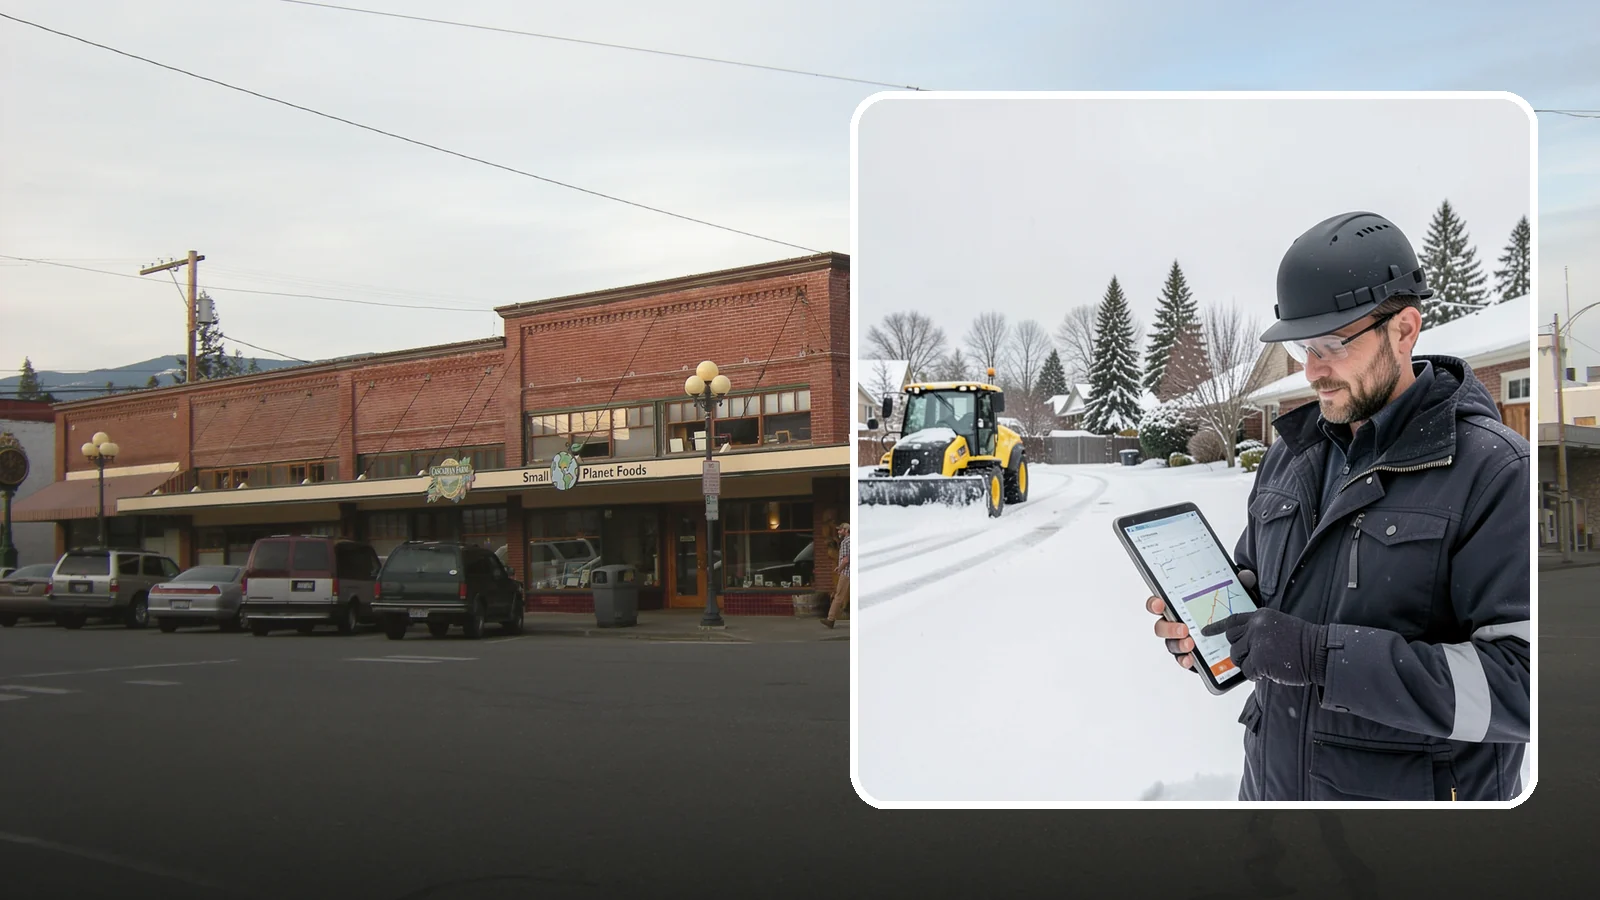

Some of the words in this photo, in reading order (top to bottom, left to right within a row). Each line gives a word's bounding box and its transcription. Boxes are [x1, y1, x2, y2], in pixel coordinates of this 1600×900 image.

[523, 470, 549, 483] Small
[583, 467, 613, 479] Planet
[617, 464, 647, 477] Foods
